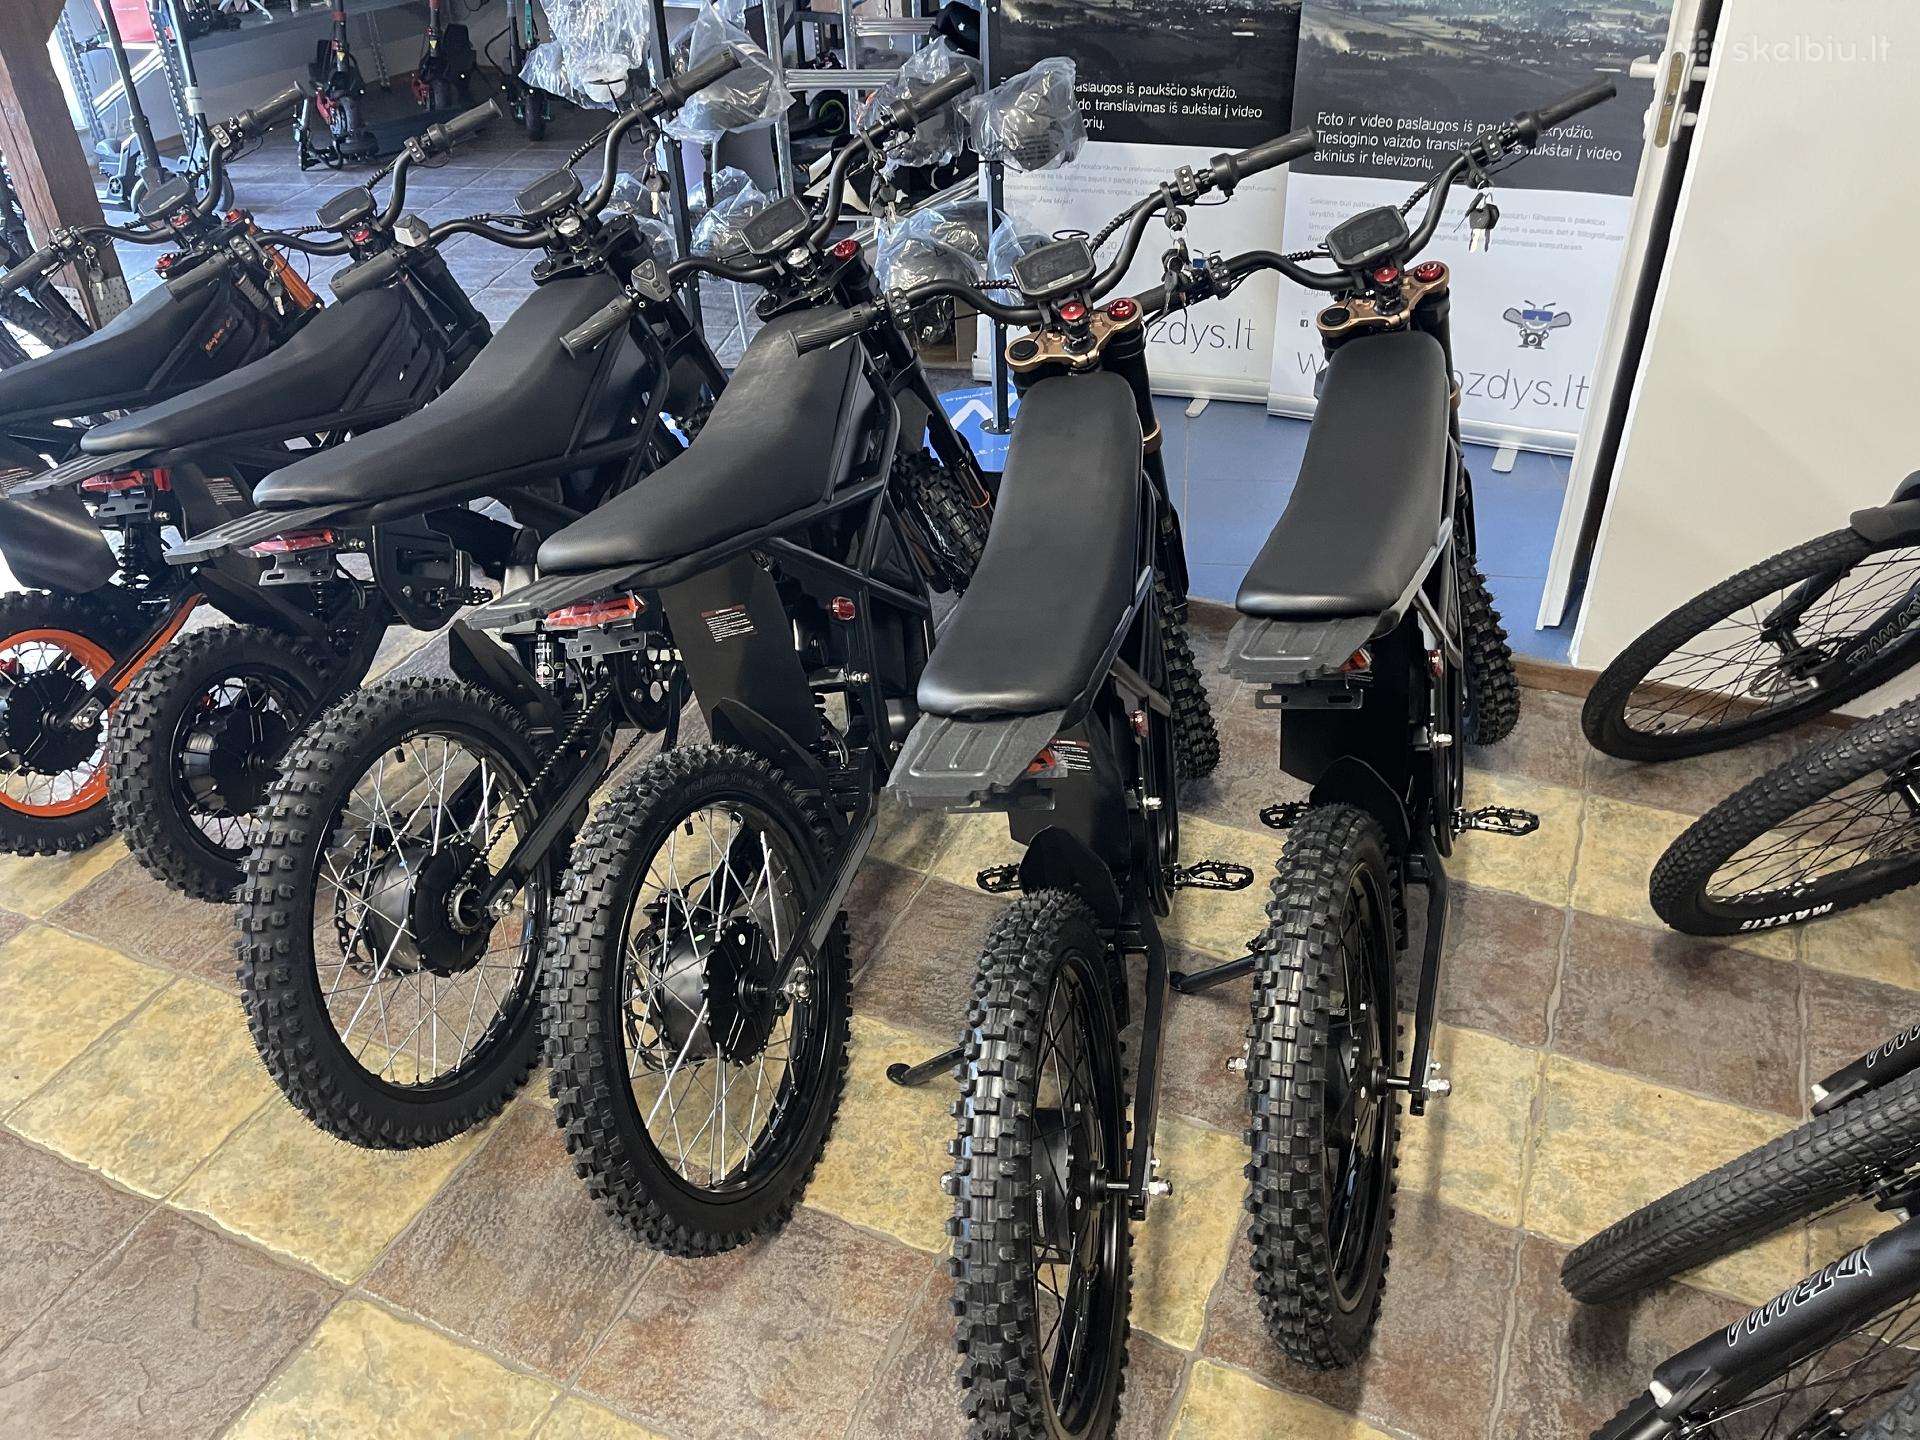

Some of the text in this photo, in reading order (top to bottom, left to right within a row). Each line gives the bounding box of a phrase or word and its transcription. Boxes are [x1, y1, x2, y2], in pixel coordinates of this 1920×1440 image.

[1074, 82, 1238, 100] aslaugos iš paukščio skrydžio.
[1095, 99, 1166, 113] transliavimas
[1169, 100, 1178, 113] iš
[1181, 102, 1222, 116] aukštai
[1231, 104, 1263, 118] video
[1317, 111, 1344, 126] Foto
[1348, 112, 1356, 126] ir
[1360, 113, 1393, 128] video
[1396, 116, 1459, 134] paslaugos
[1463, 119, 1473, 132] iš
[1316, 130, 1379, 148] Tiesioginio
[1383, 134, 1422, 149] vaizdo
[1586, 147, 1622, 161] video
[1313, 149, 1434, 170] akinius ir televizorių.
[1150, 318, 1256, 354] zdys.lt
[1739, 901, 1834, 930] MAXXIS
